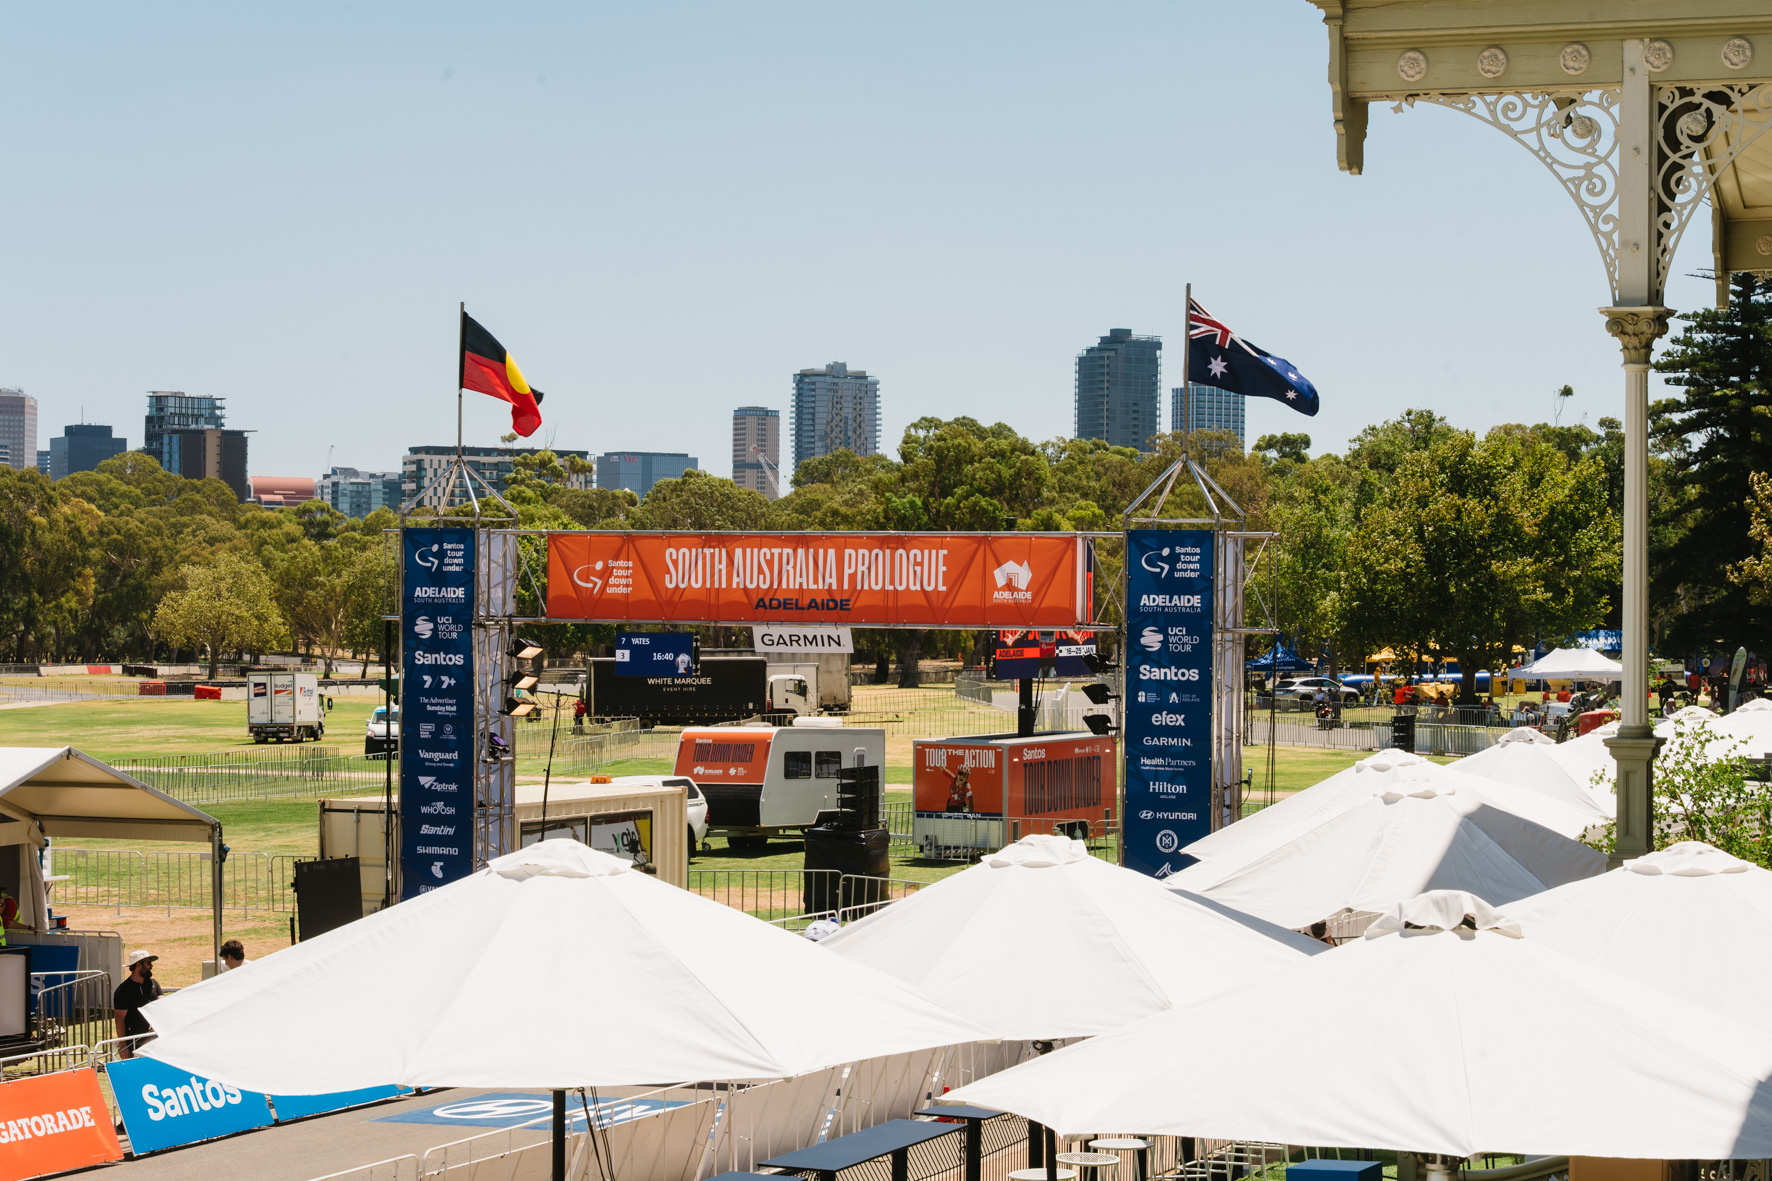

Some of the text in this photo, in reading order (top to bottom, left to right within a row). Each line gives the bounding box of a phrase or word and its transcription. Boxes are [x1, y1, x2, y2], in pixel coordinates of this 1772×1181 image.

[608, 559, 633, 568] Santos
[665, 548, 948, 591] SOUTH AUSTRALIA PROLOGUE
[608, 576, 632, 585] down
[414, 587, 465, 598] ADELAIDE
[606, 585, 632, 594] under
[754, 598, 851, 611] ADELAIDE
[1140, 595, 1201, 606] ADELAIDE
[761, 633, 841, 647] GARMIN
[415, 650, 464, 665] Santos
[998, 649, 1024, 658] ADELAIDE
[1139, 664, 1199, 681] Santos
[1152, 711, 1185, 726] efex
[1143, 737, 1191, 746] GARMIN
[418, 749, 458, 761] Vanguard
[693, 744, 755, 762] TOUR DOWN UNDER
[925, 749, 947, 767] TOUR
[964, 750, 995, 768] ACTION
[1023, 748, 1046, 760] Santos
[1165, 758, 1196, 766] Partners
[1024, 756, 1101, 815] TOUR DOWN UNDER
[1149, 781, 1187, 793] Hilton
[421, 806, 455, 814] WHOOSH
[1156, 812, 1196, 820] HYUNDAI
[420, 824, 456, 835] Santini
[417, 846, 458, 855] SHIMANO
[142, 1076, 242, 1121] Santos
